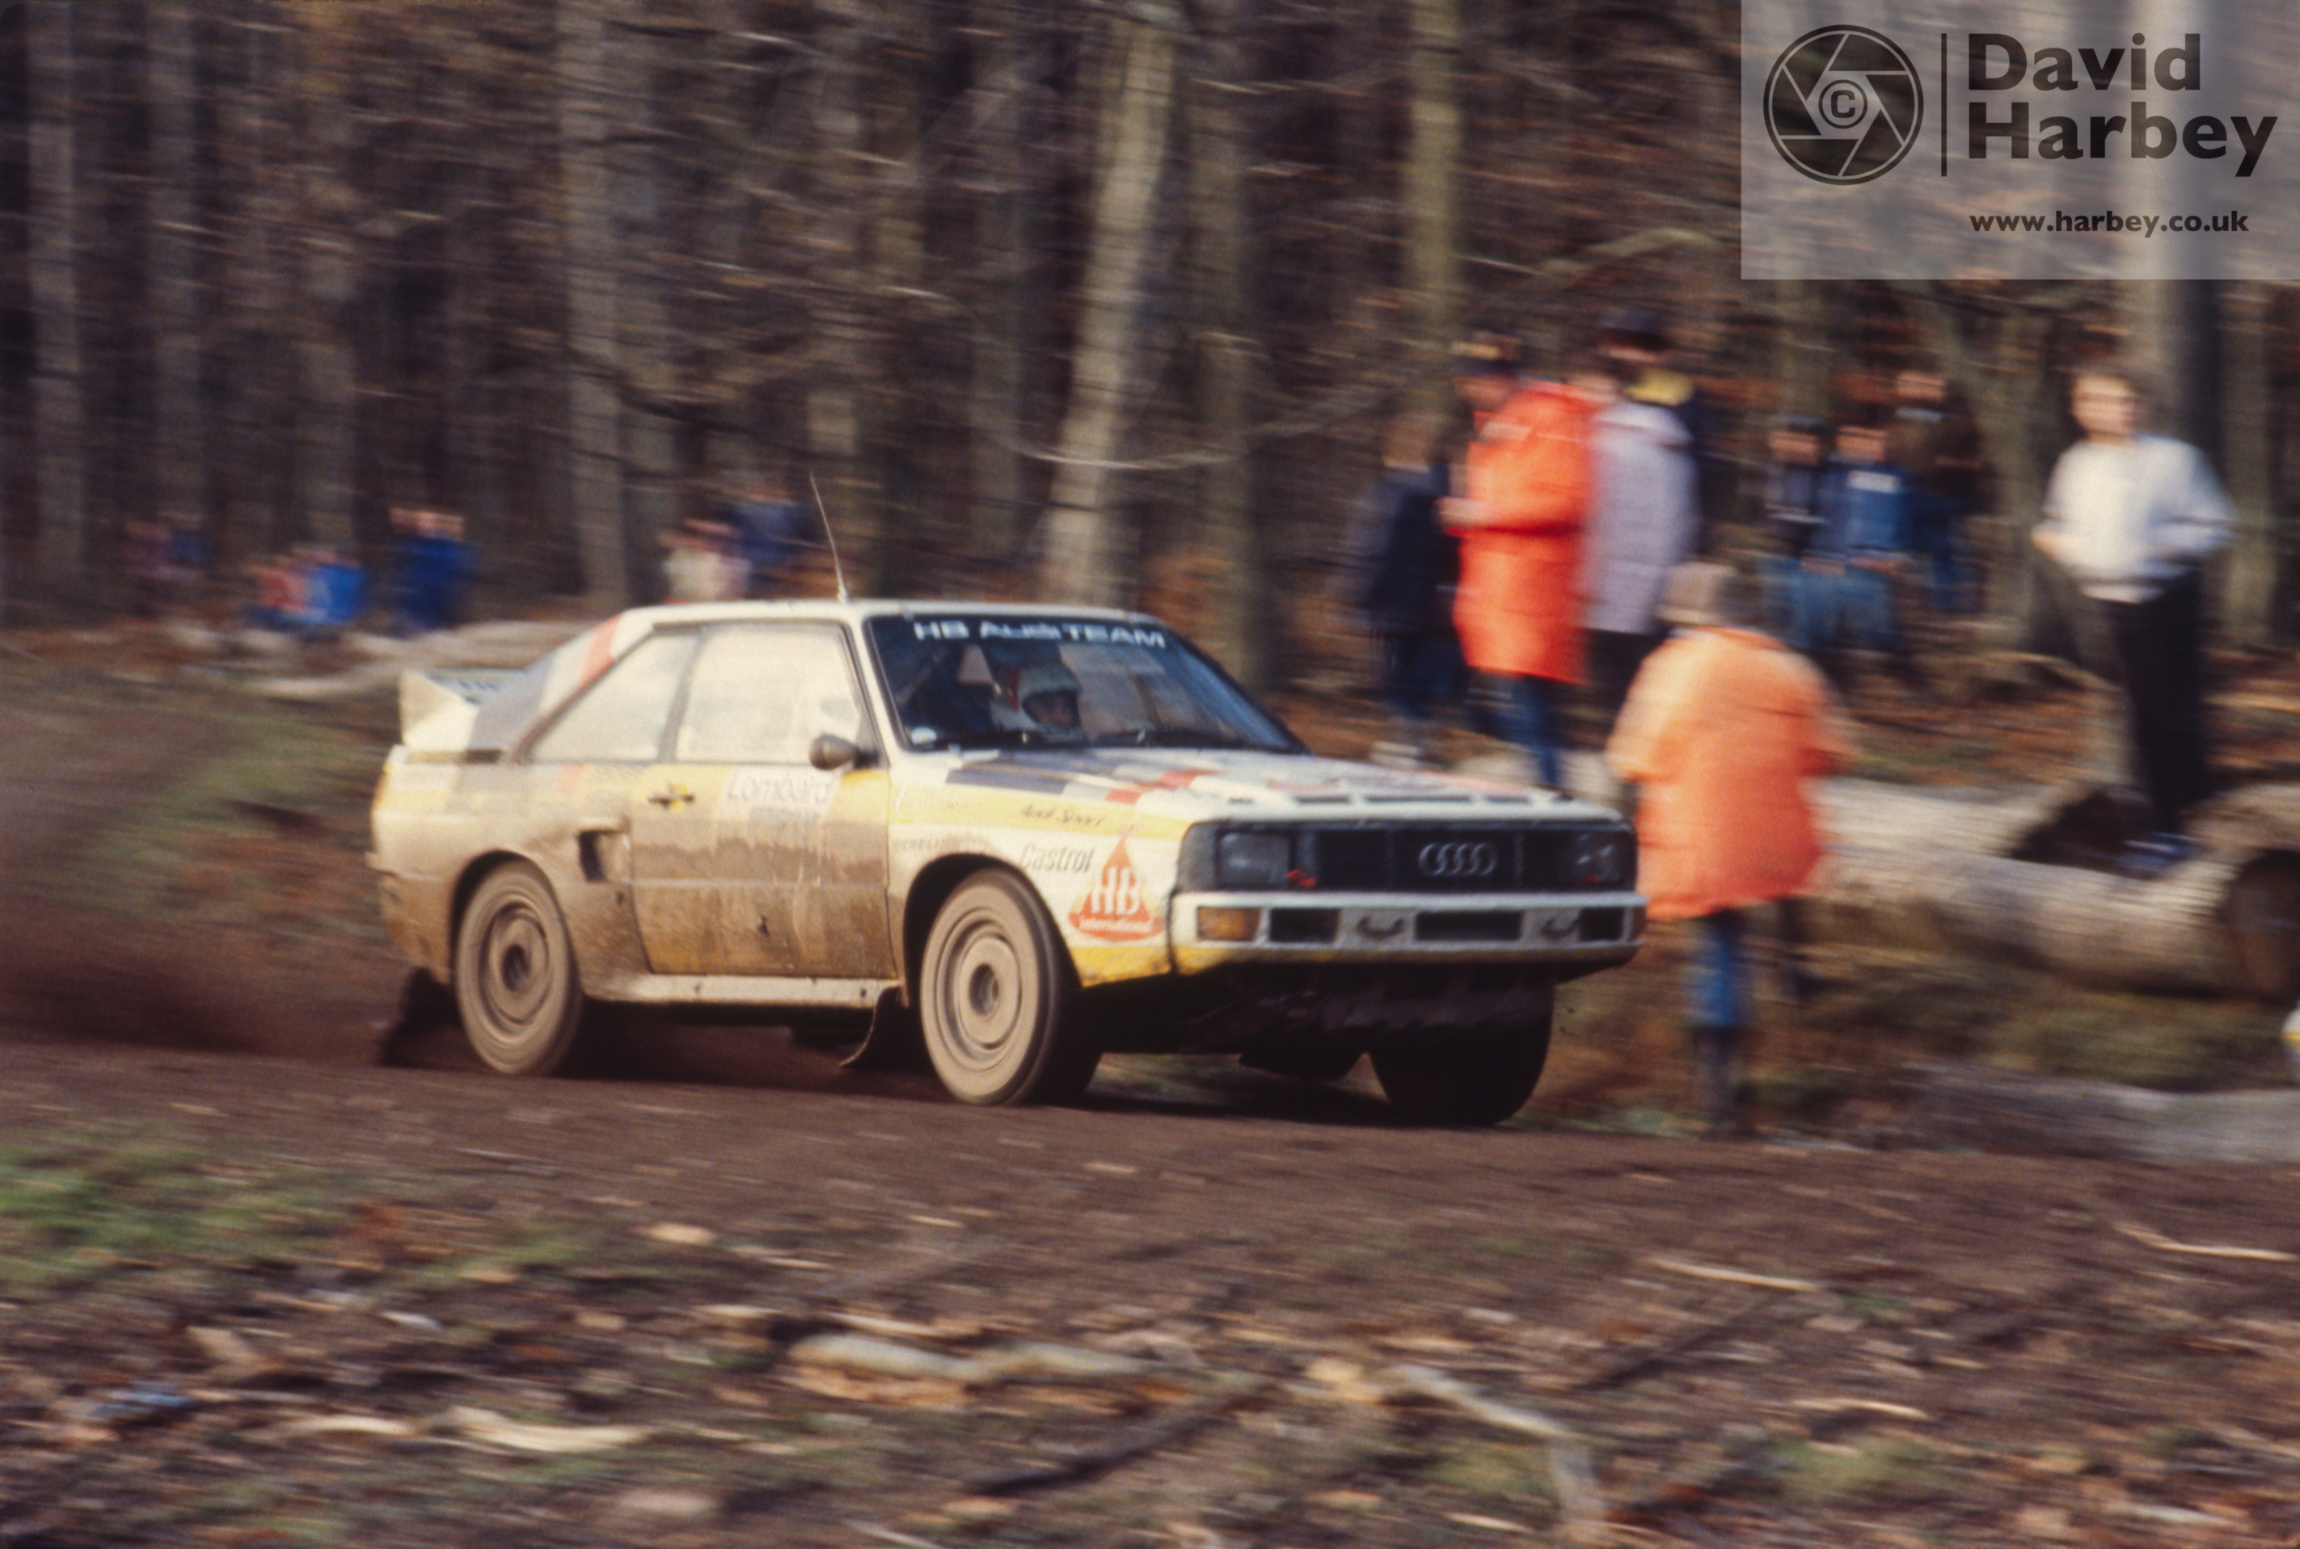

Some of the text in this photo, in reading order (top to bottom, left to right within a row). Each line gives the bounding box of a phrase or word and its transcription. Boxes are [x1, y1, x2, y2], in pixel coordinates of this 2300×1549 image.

[913, 620, 970, 640] HB
[1020, 842, 1094, 874] Castrol
[1090, 866, 1142, 916] HB
